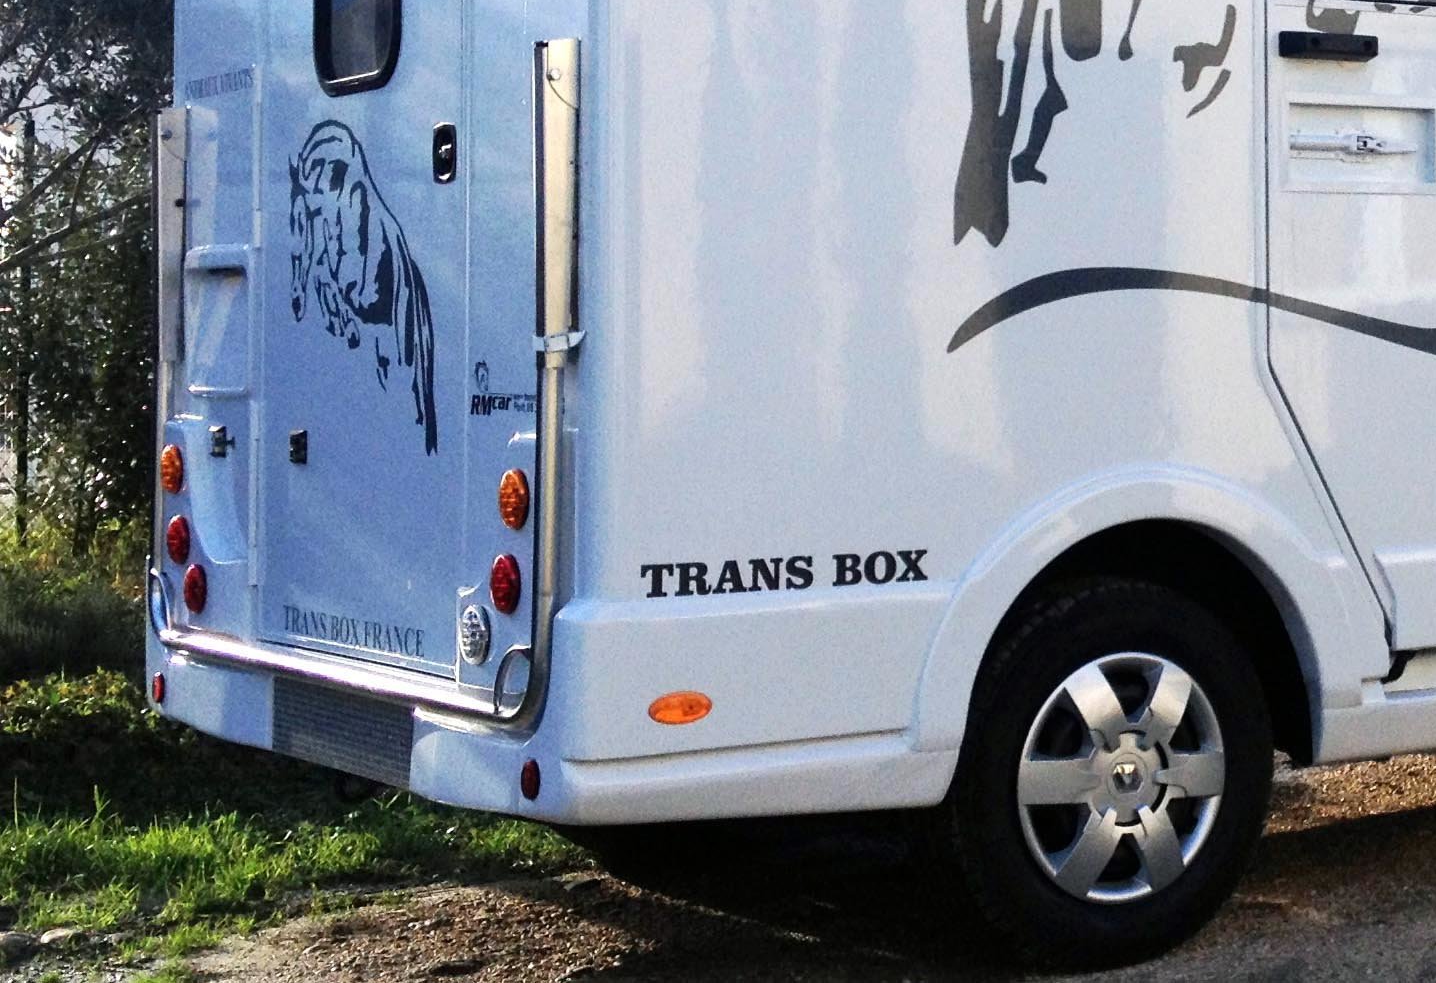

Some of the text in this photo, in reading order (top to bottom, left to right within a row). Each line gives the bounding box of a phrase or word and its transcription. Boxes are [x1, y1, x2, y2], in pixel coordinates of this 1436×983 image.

[470, 394, 512, 416] RMcar
[640, 549, 928, 598] TRANS BOX
[283, 604, 425, 658] TRANS BOX FRANCE
